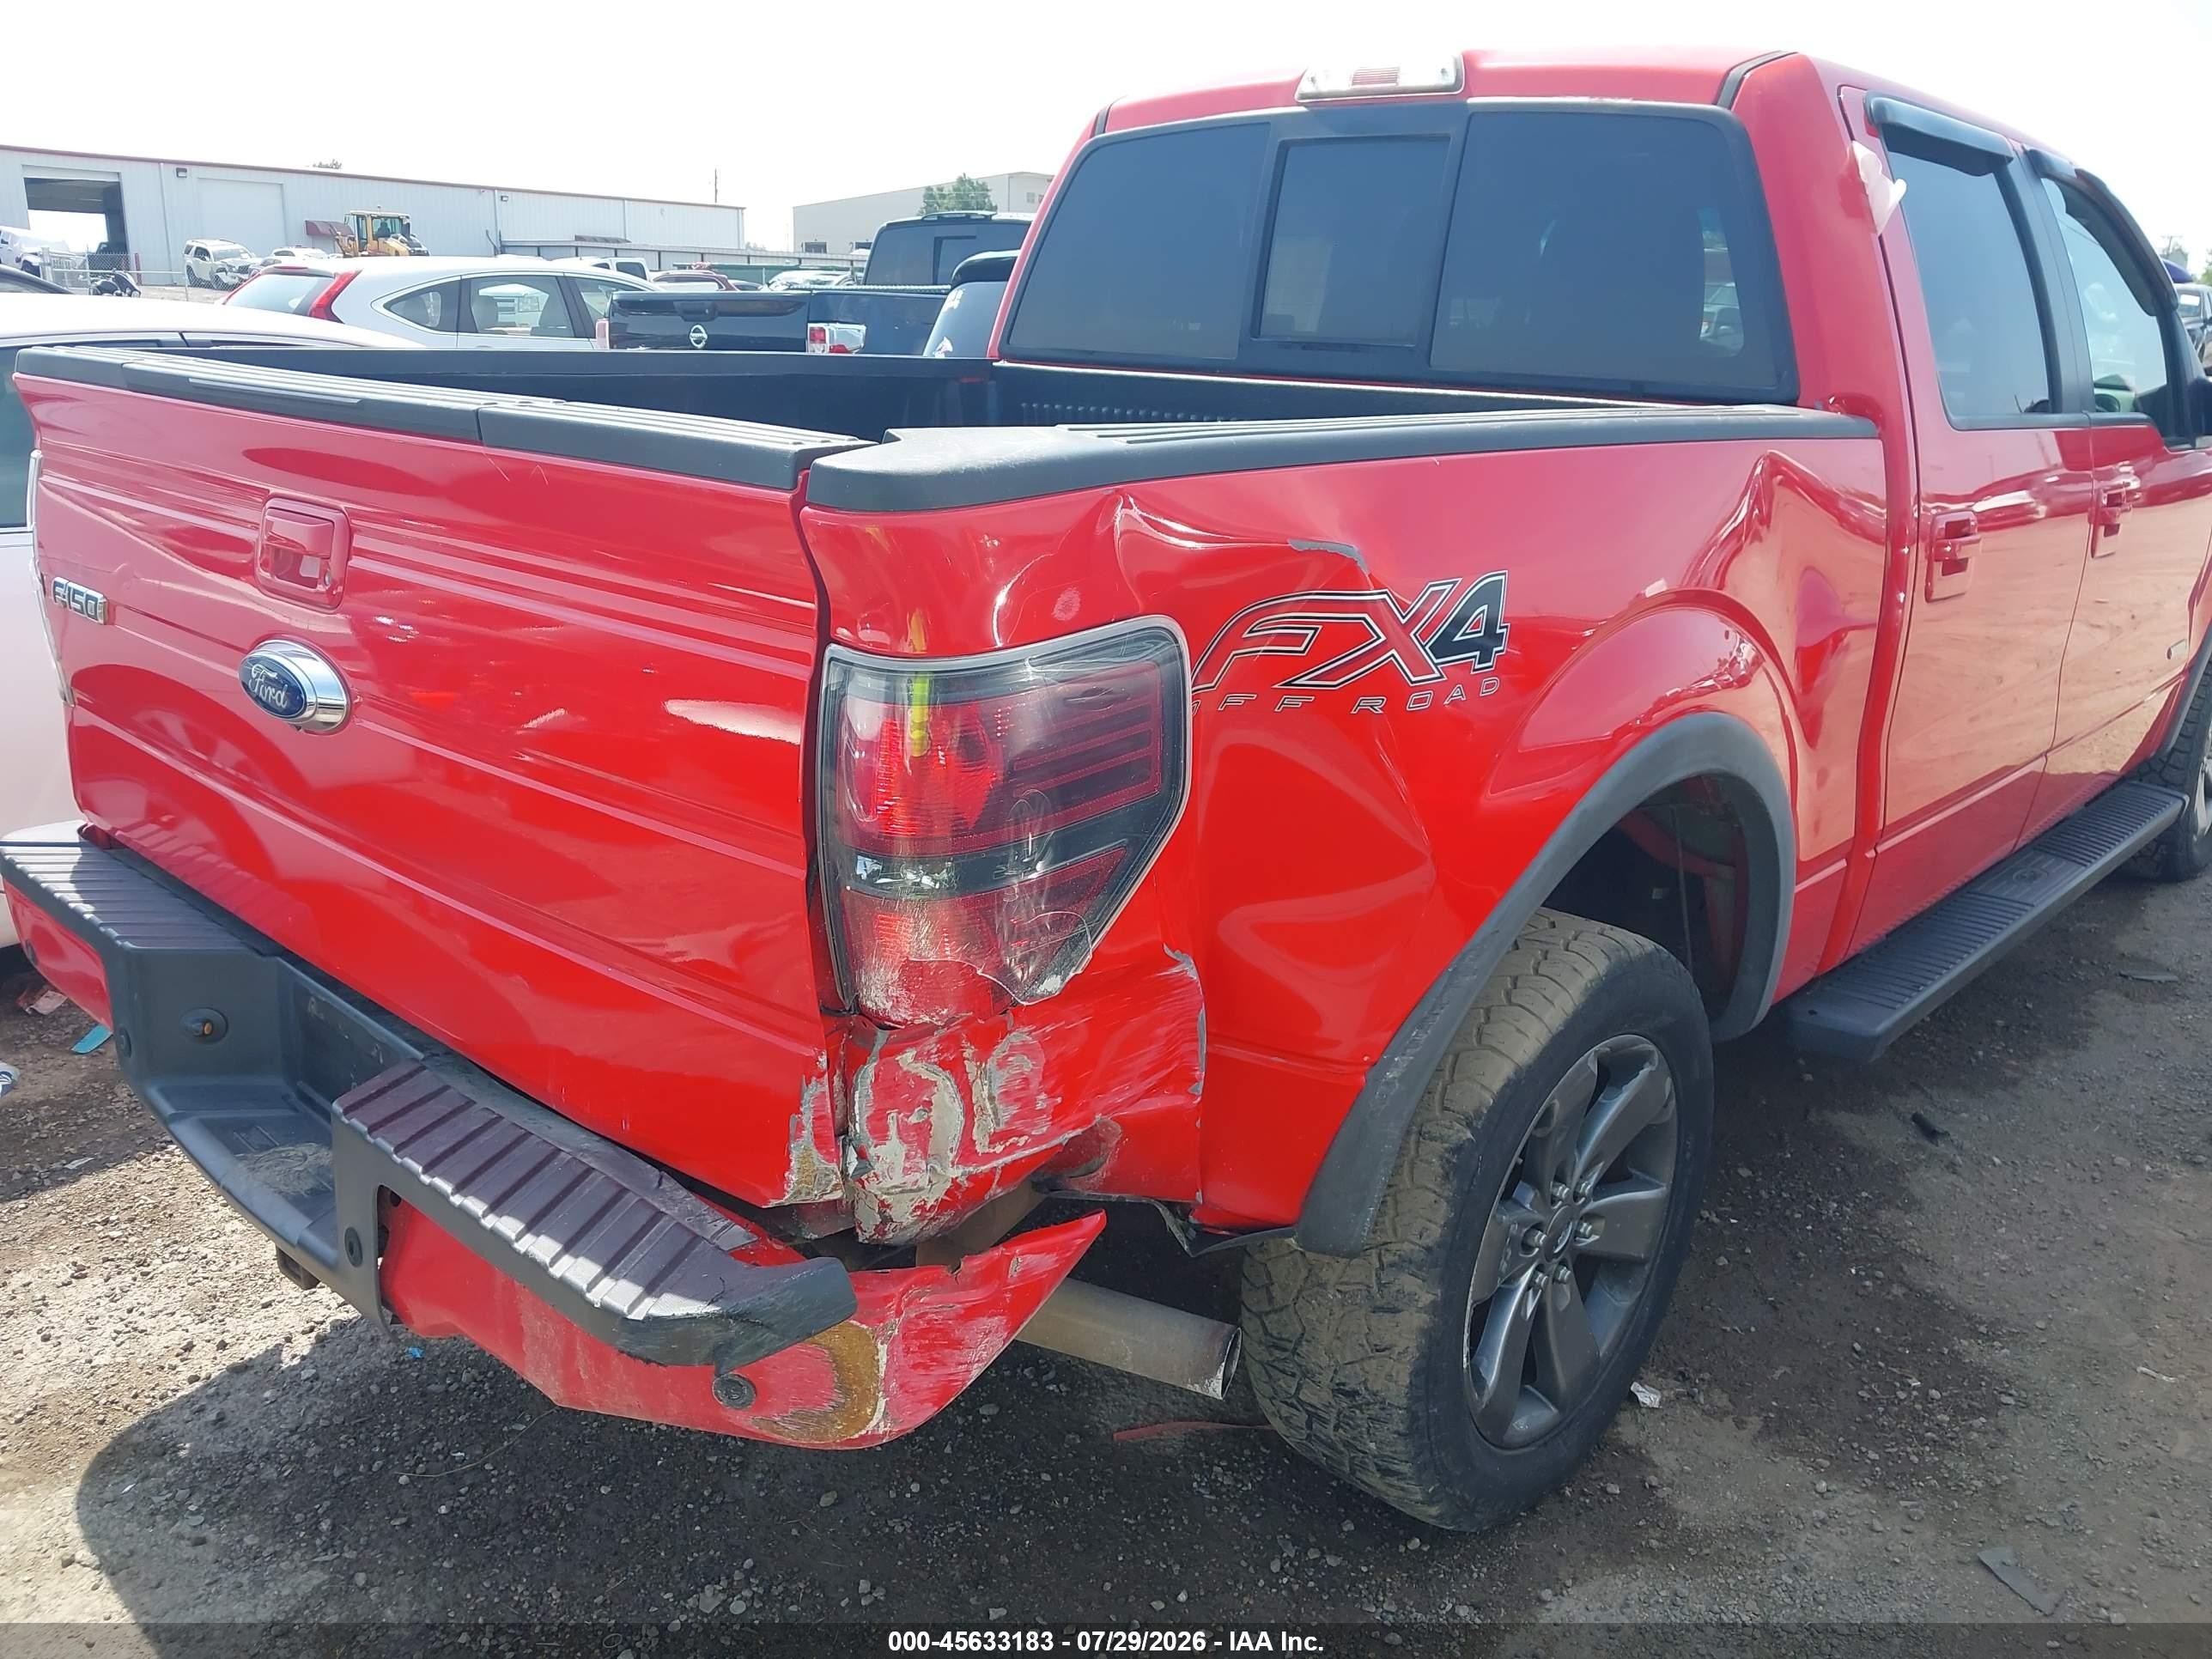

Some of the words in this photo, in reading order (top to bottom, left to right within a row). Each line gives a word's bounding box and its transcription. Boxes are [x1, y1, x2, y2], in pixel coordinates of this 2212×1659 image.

[1190, 569, 1511, 692] FX4
[248, 663, 289, 708] Ford
[1350, 677, 1500, 714] ROAD
